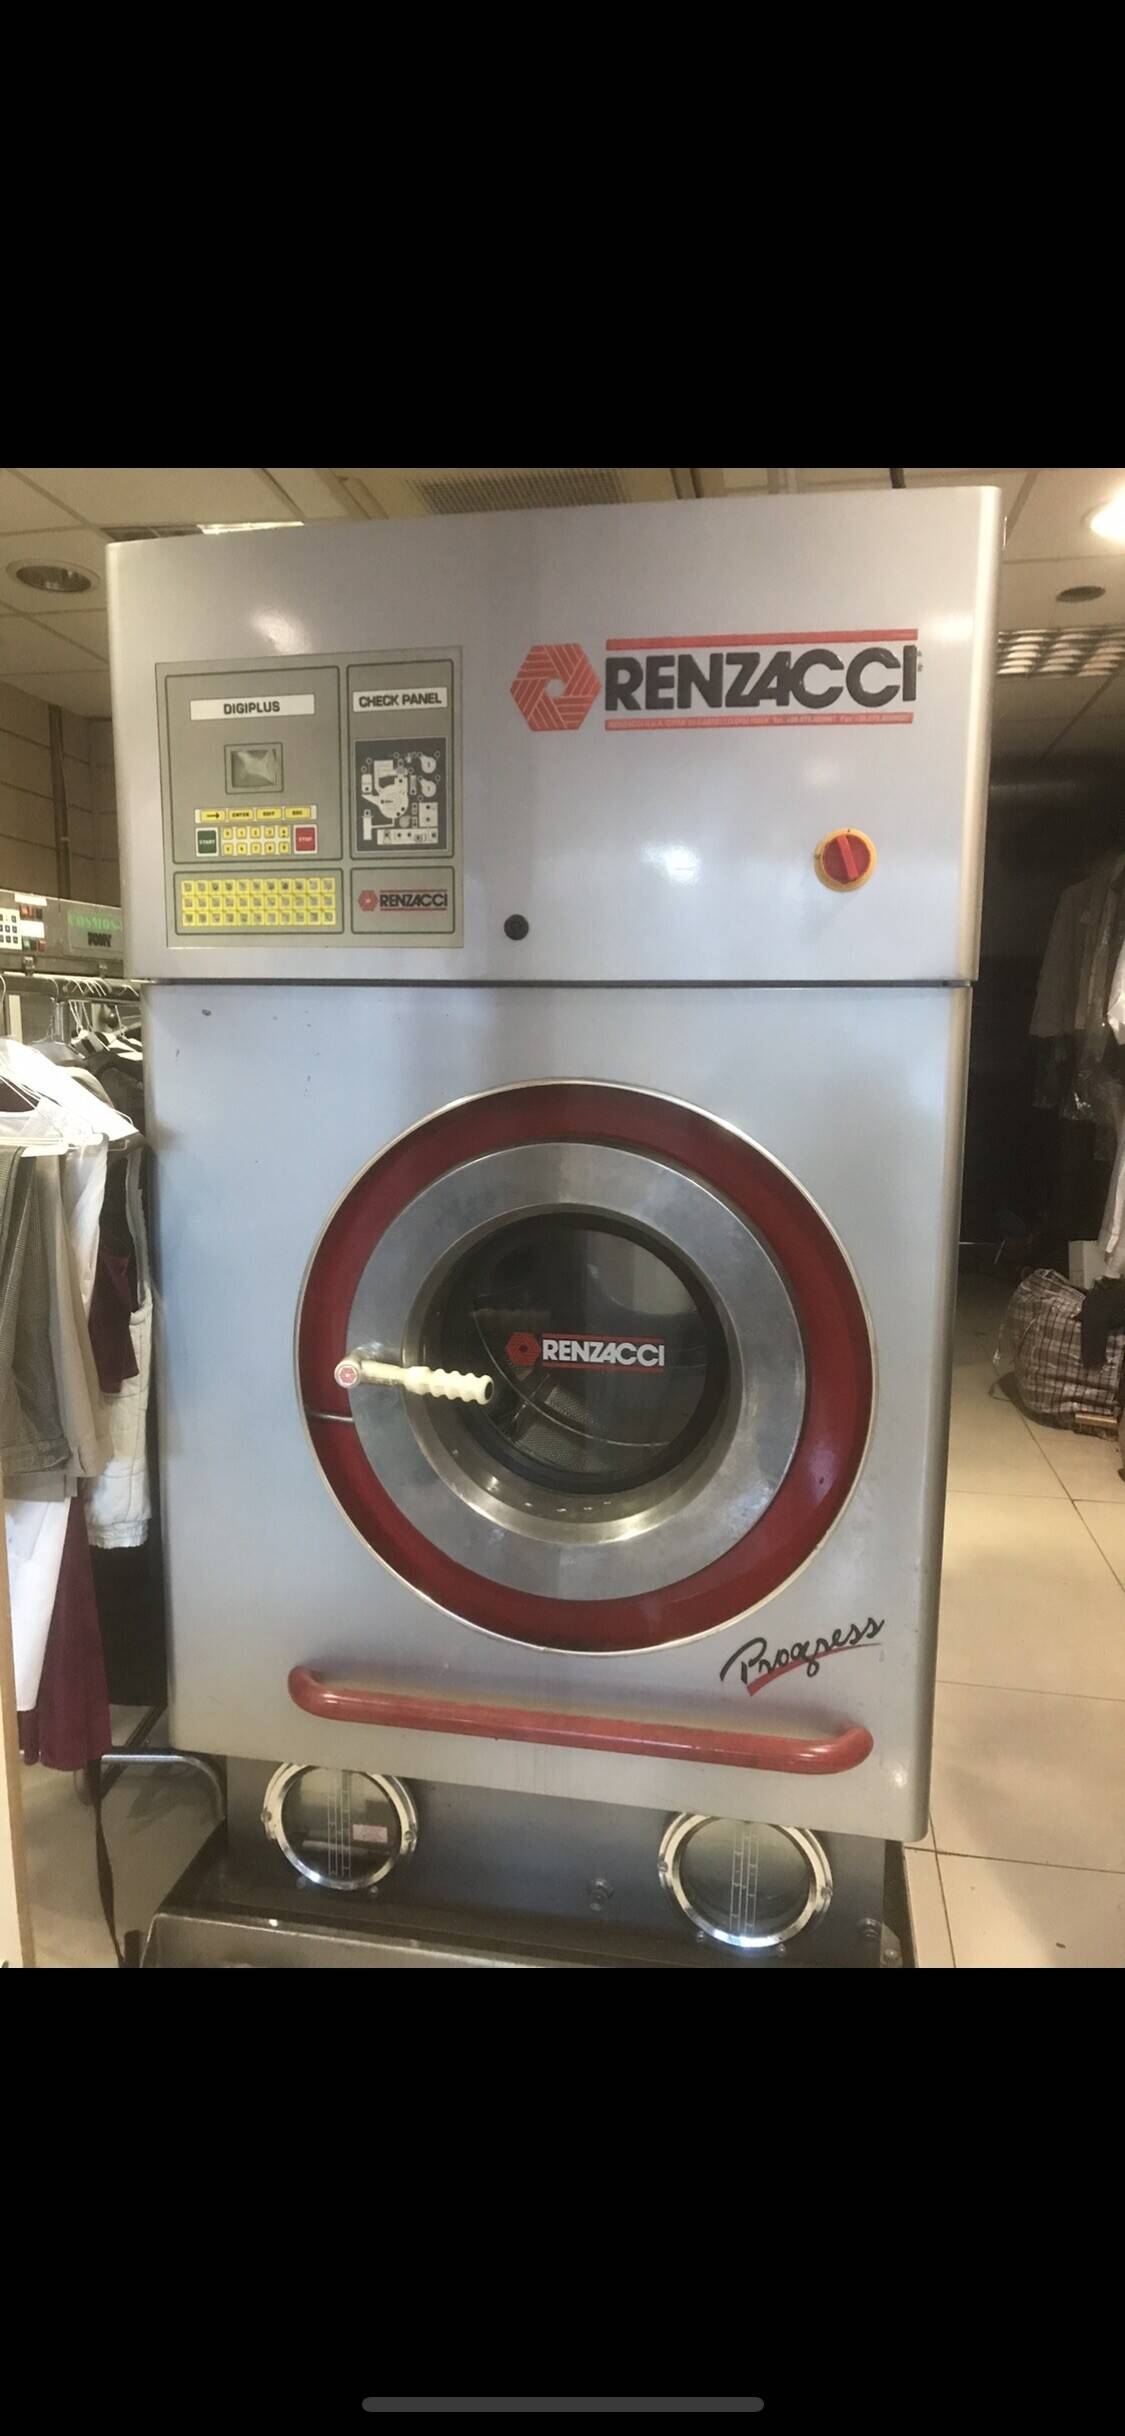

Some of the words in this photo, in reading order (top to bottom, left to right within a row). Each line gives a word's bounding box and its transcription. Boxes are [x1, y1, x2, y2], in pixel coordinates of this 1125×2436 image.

[605, 645, 917, 710] RENZACCI
[223, 701, 281, 715] DIGIPLUS
[359, 695, 399, 708] CHECK
[402, 692, 442, 706] PANEL
[380, 893, 448, 908] RENZACCI
[542, 1339, 665, 1367] RENZACCI
[720, 1617, 885, 1684] Progress
